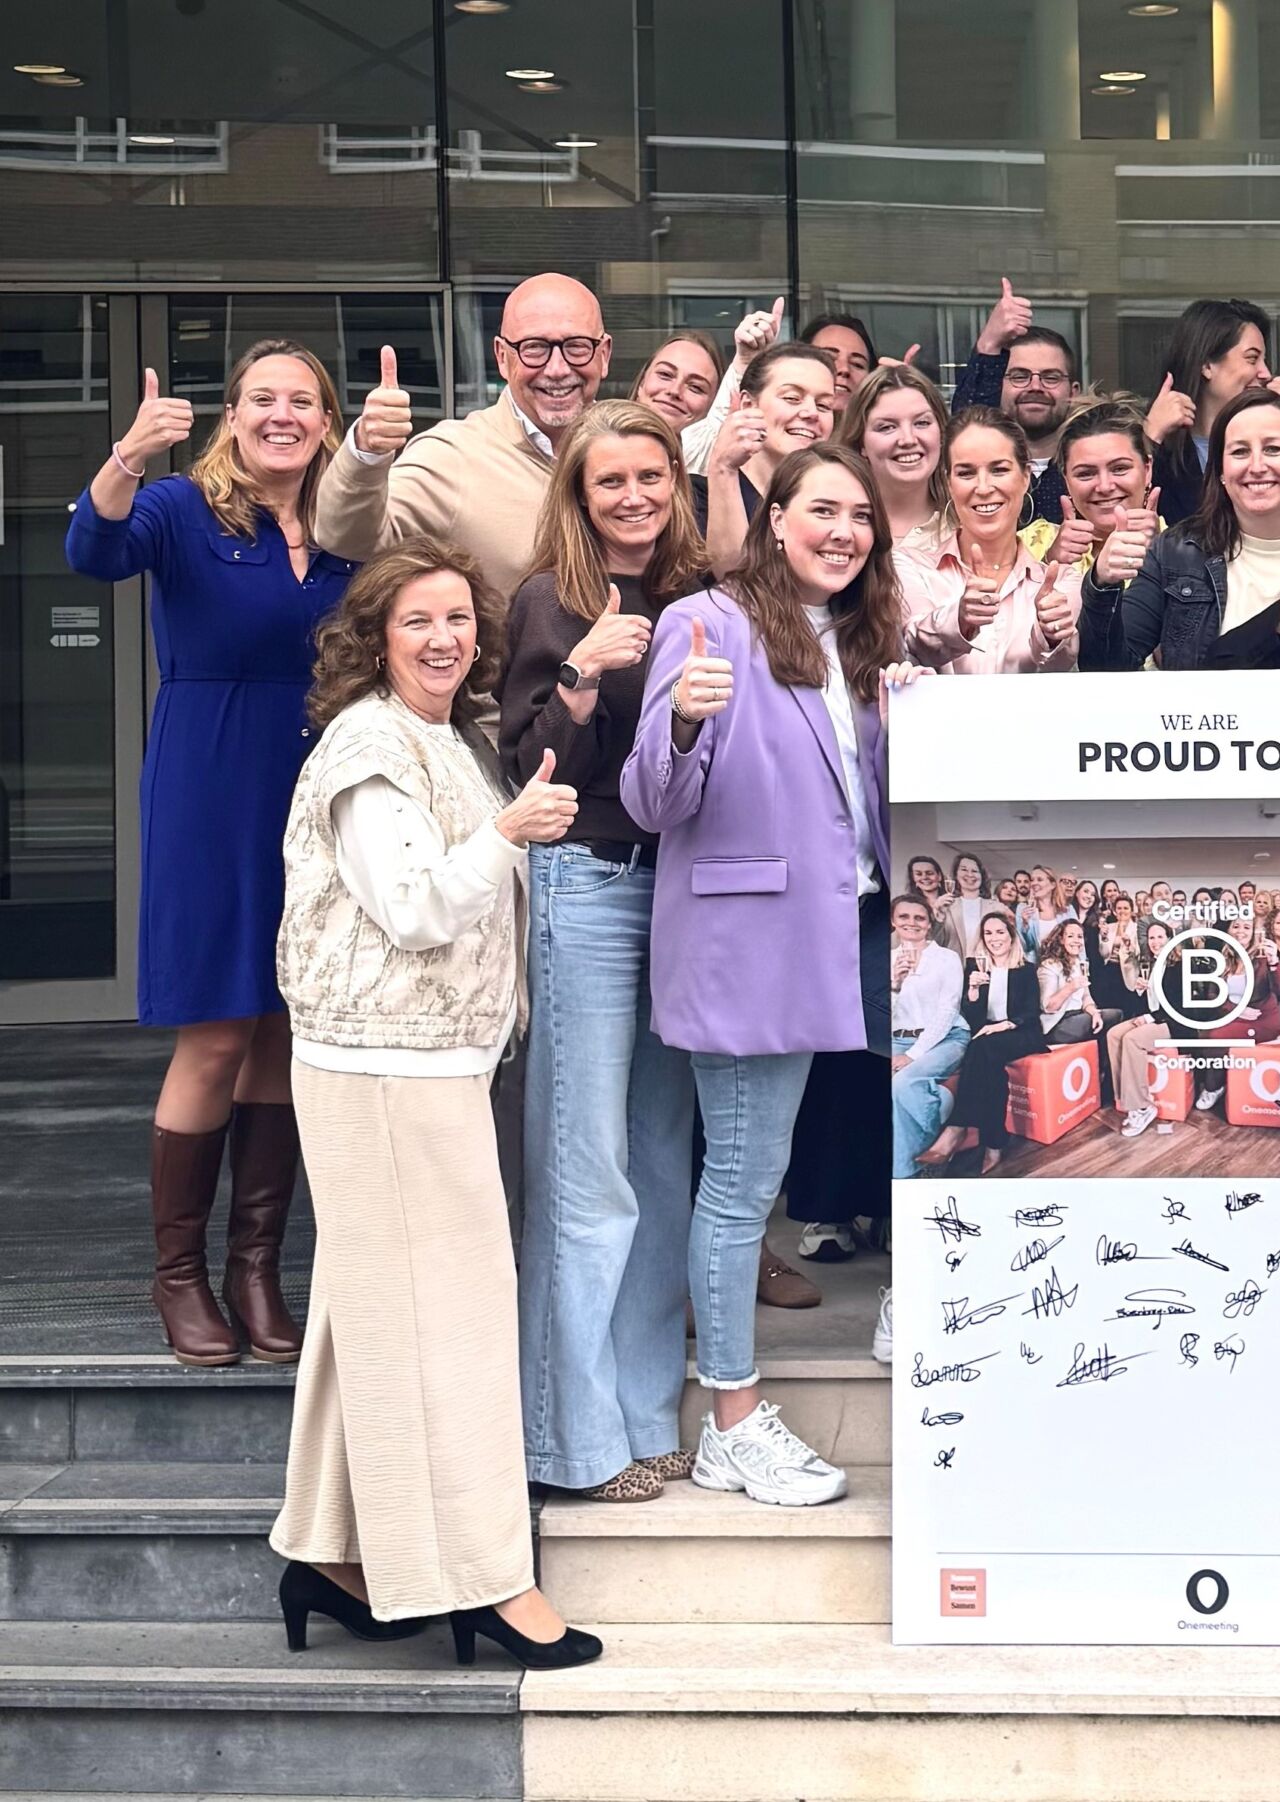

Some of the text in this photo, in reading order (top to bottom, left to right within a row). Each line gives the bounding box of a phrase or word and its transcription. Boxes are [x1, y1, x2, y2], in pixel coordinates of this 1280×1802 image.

[1161, 714, 1239, 731] WE ARE
[1079, 741, 1220, 772] PROUD
[1151, 900, 1255, 922] Certified
[1181, 948, 1229, 1009] B
[1155, 1054, 1257, 1072] Corporation
[1177, 1620, 1240, 1633] Onemeeting
